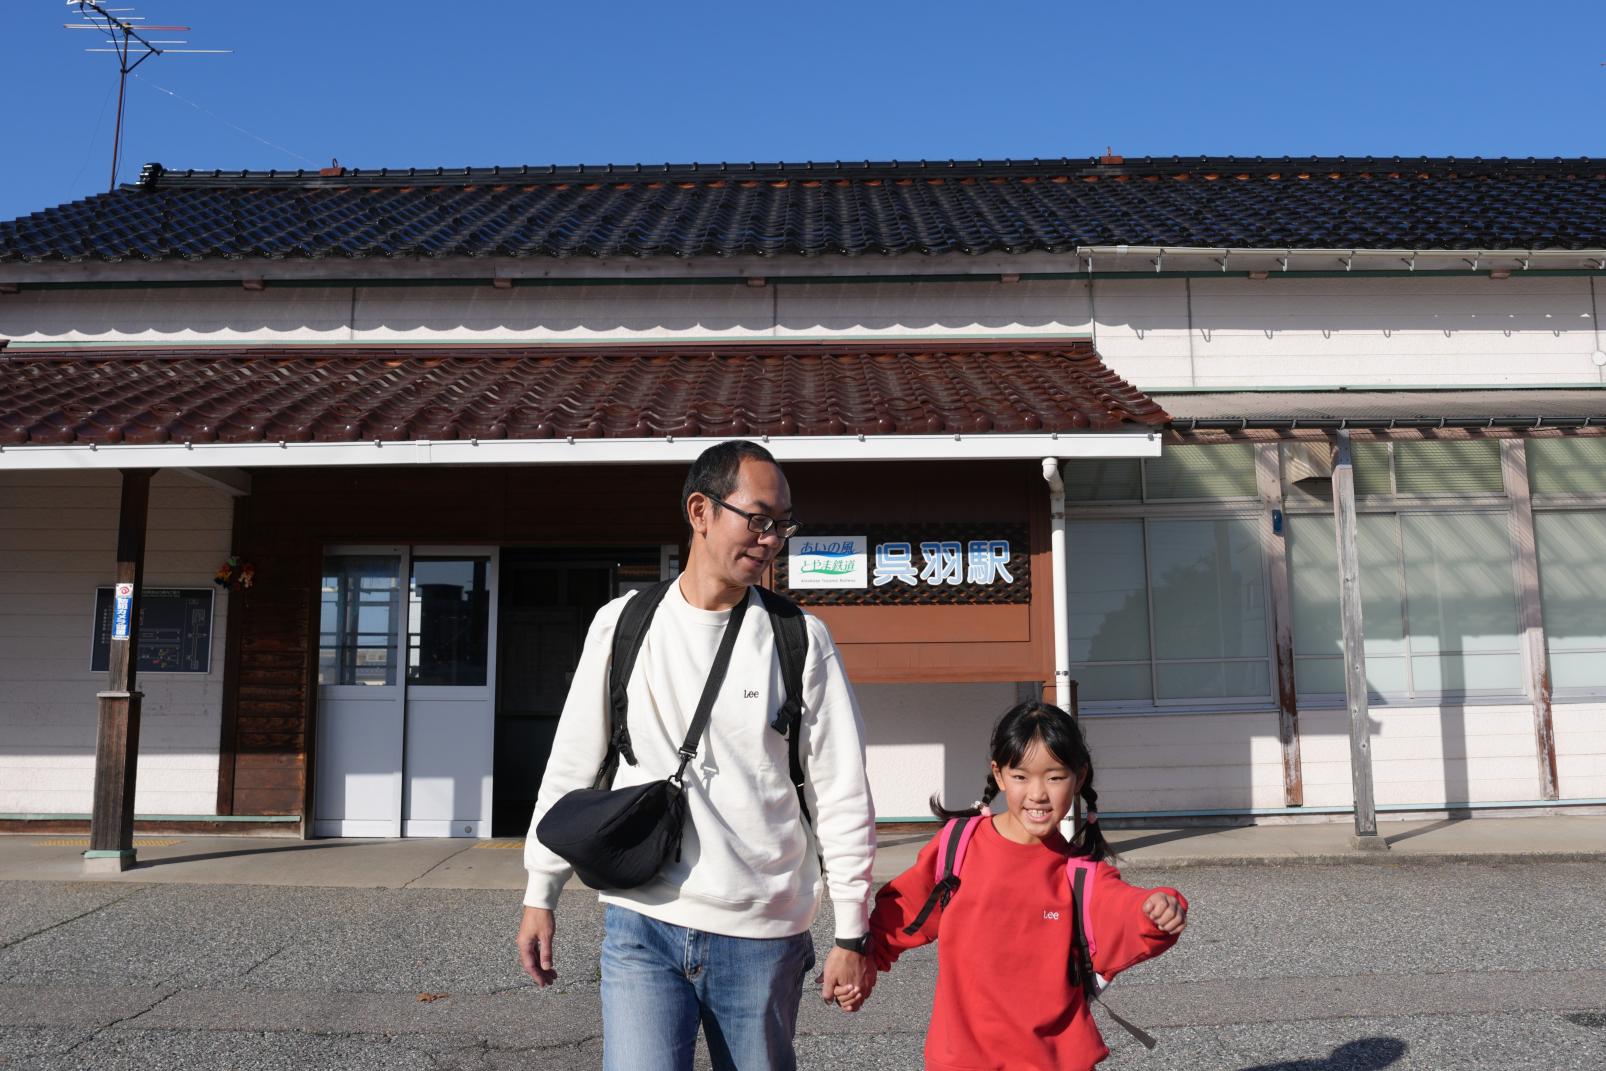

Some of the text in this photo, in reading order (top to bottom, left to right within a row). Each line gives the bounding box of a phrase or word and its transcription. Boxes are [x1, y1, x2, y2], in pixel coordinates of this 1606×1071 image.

[800, 541, 855, 555] あいの風
[800, 560, 856, 574] とやま鉄道
[873, 541, 1014, 586] 呉羽駅
[743, 689, 759, 699] Lee
[1043, 910, 1059, 919] Lee
